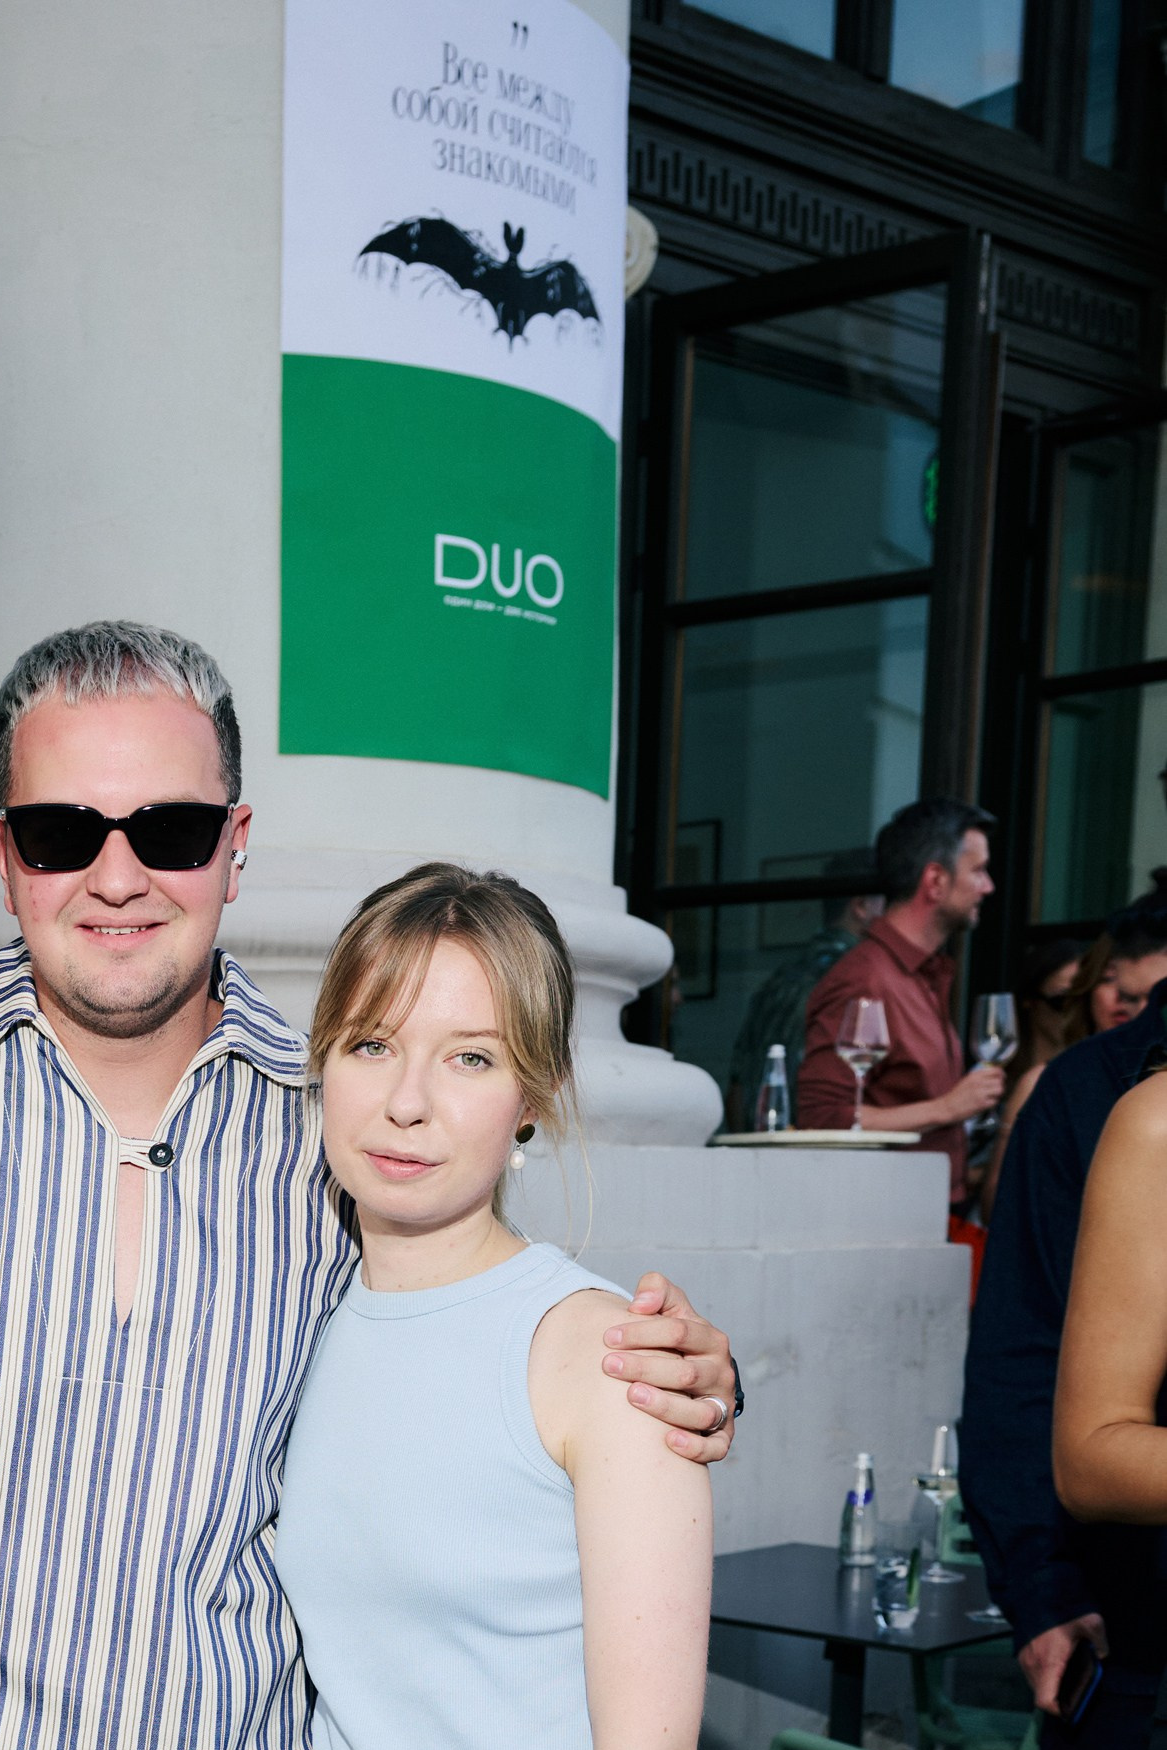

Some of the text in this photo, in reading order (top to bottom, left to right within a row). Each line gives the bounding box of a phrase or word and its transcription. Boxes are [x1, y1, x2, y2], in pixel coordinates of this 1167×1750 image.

[391, 86, 479, 135] собой
[442, 42, 574, 136] Все между
[433, 138, 577, 215] знакомыми
[434, 533, 564, 608] DUO
